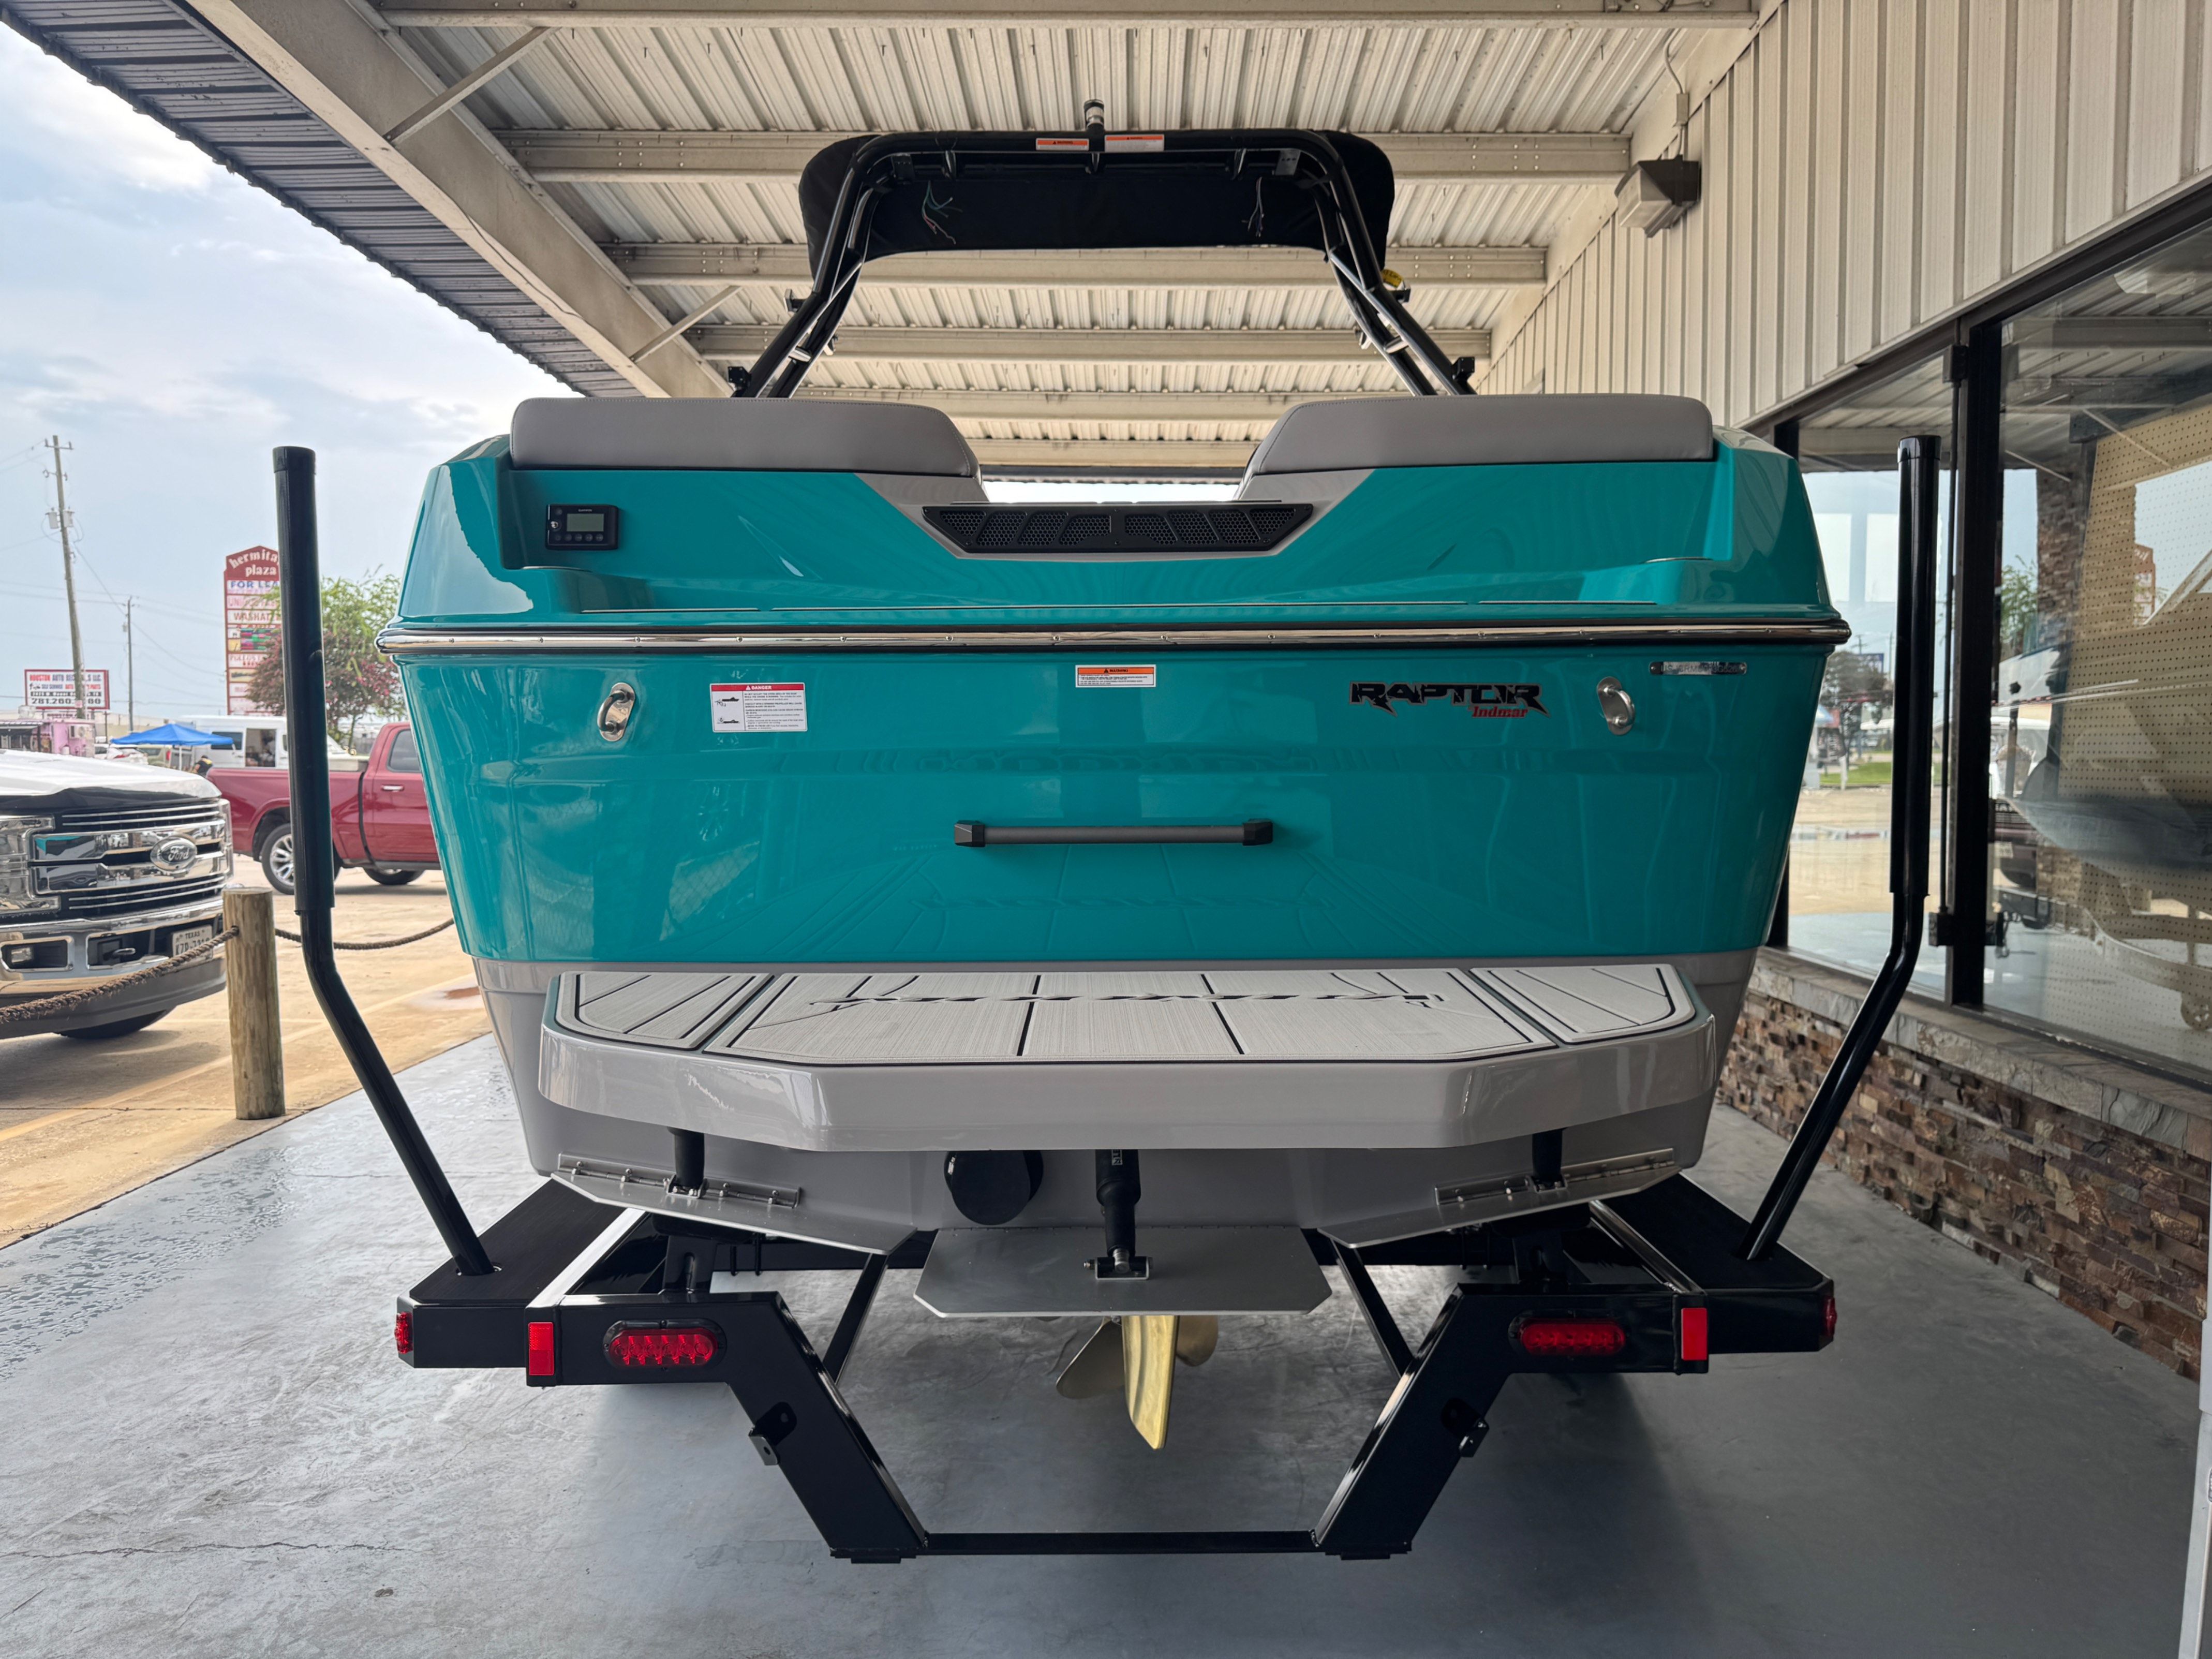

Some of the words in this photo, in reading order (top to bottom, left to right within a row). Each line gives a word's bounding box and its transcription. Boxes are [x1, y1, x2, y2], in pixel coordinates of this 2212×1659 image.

[228, 549, 279, 569] hermita
[245, 564, 277, 577] plaza
[1349, 681, 1551, 717] RAPTOR
[1471, 706, 1529, 718] Indmar
[168, 846, 190, 862] Ford
[185, 930, 200, 940] TEXAS
